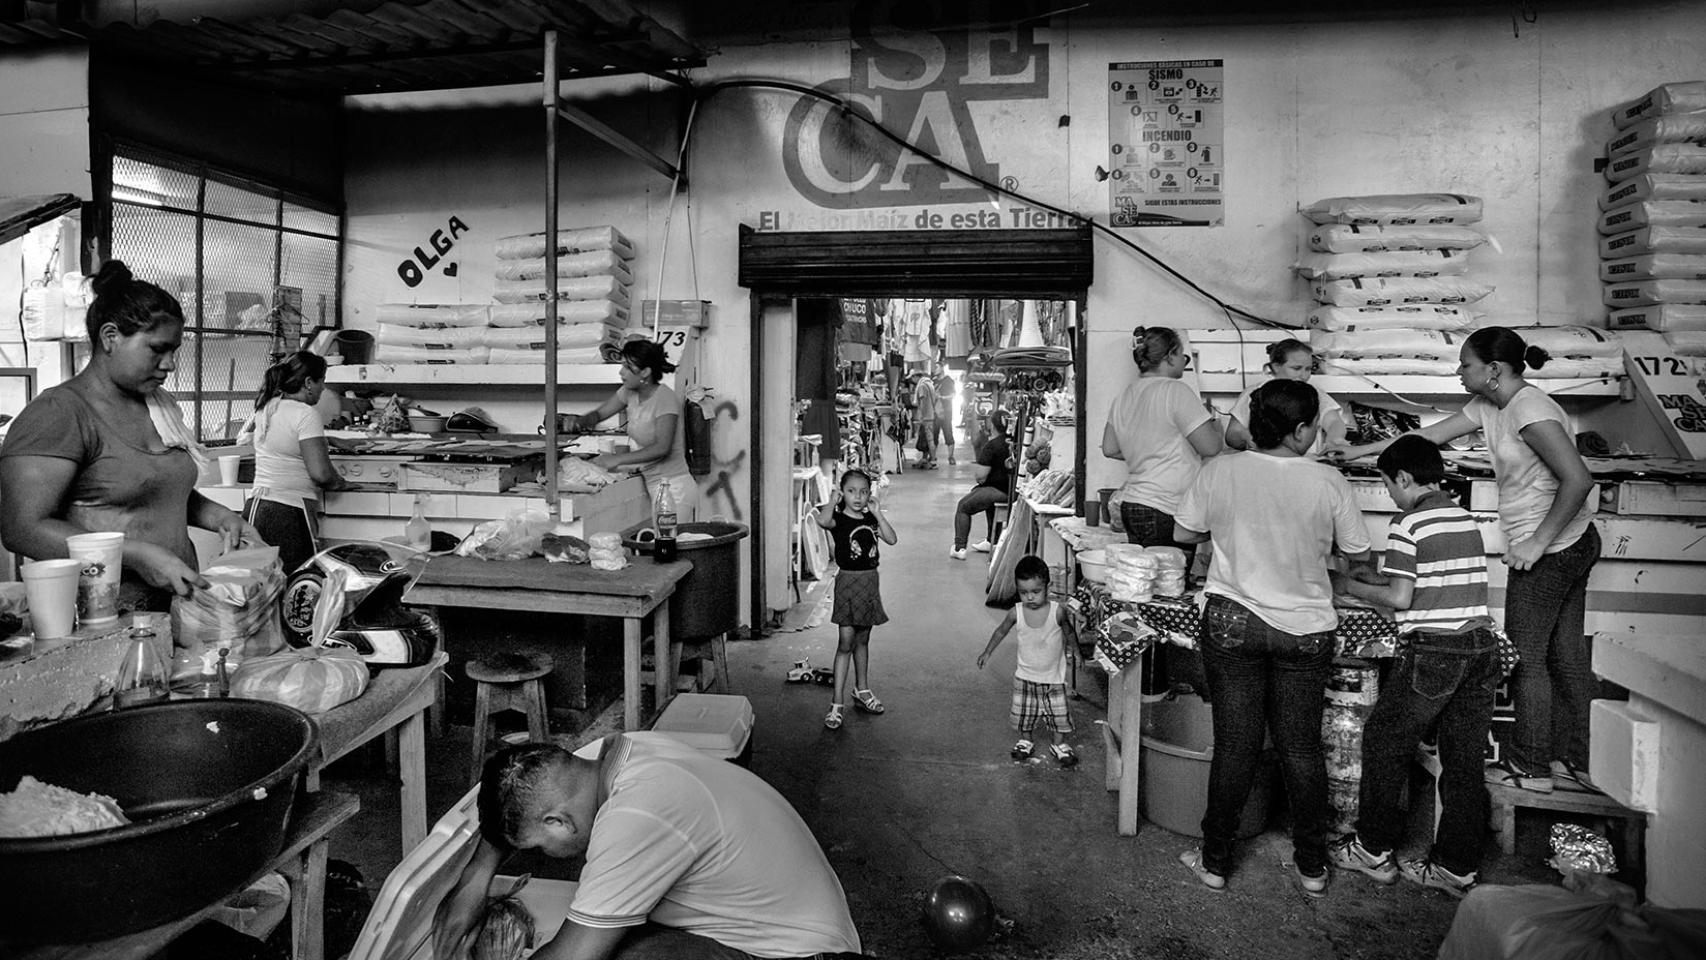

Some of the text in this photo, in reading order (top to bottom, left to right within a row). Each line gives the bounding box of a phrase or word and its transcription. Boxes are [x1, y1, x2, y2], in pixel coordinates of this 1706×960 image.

[1148, 69, 1183, 80] SISMO
[795, 88, 985, 196] CA
[1142, 130, 1192, 142] INCENDIO
[759, 211, 780, 231] El
[914, 209, 944, 229] de
[950, 209, 1001, 229] esta
[397, 214, 470, 288] OLGA
